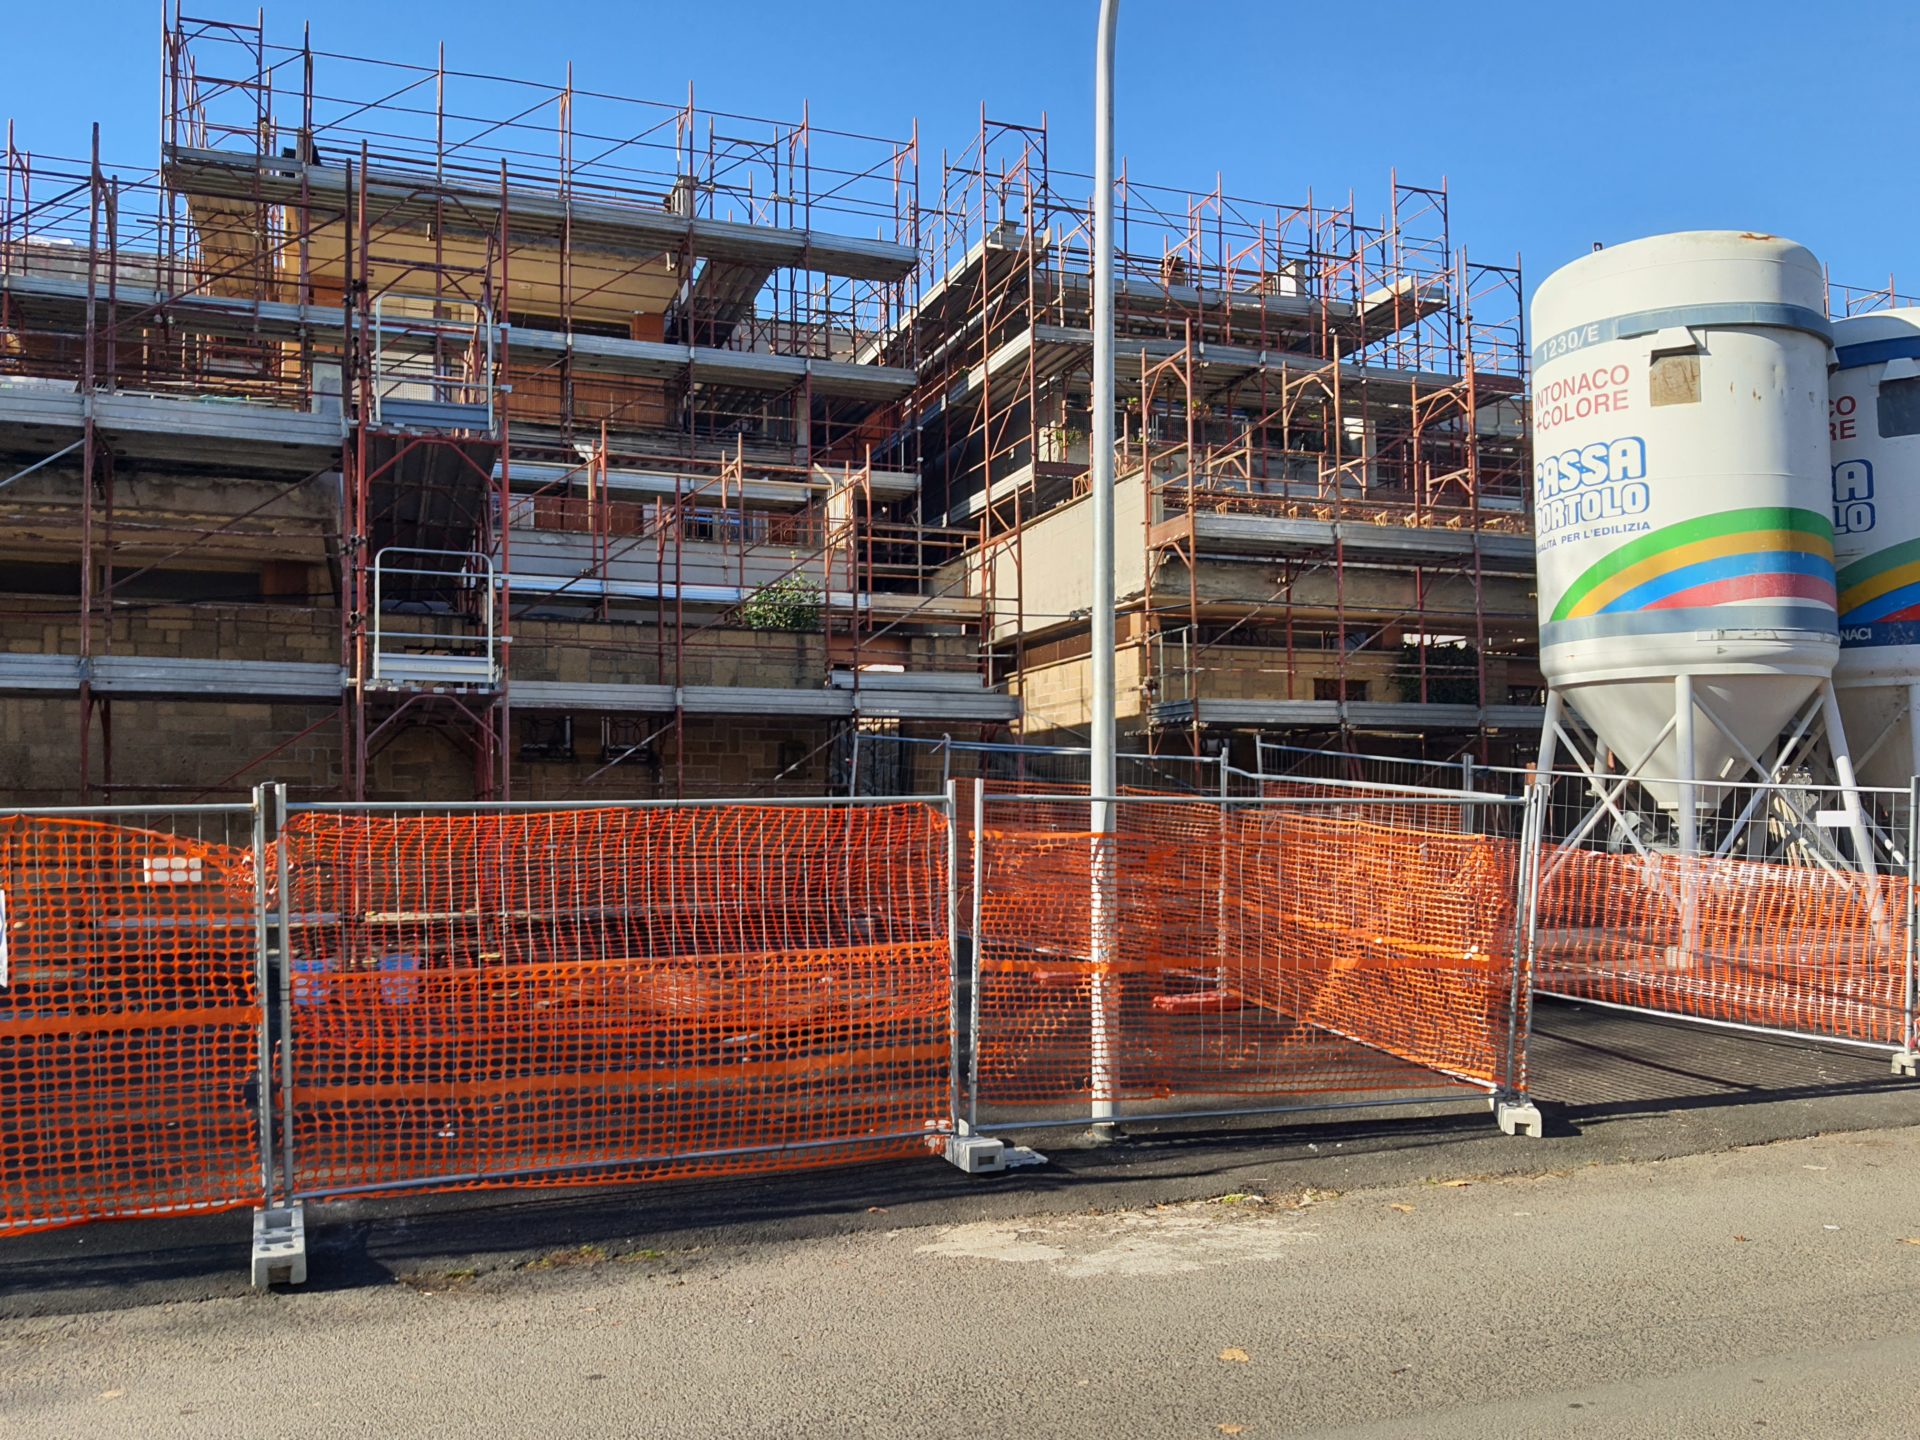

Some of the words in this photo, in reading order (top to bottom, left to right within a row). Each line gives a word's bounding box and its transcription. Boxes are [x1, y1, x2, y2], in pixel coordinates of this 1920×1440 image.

[1542, 324, 1600, 361] 1230/E
[1535, 364, 1630, 412] INTONACO
[1536, 436, 1647, 506] FASSA
[1561, 532, 1581, 545] PER
[1583, 521, 1651, 539] L'EDILIZIA
